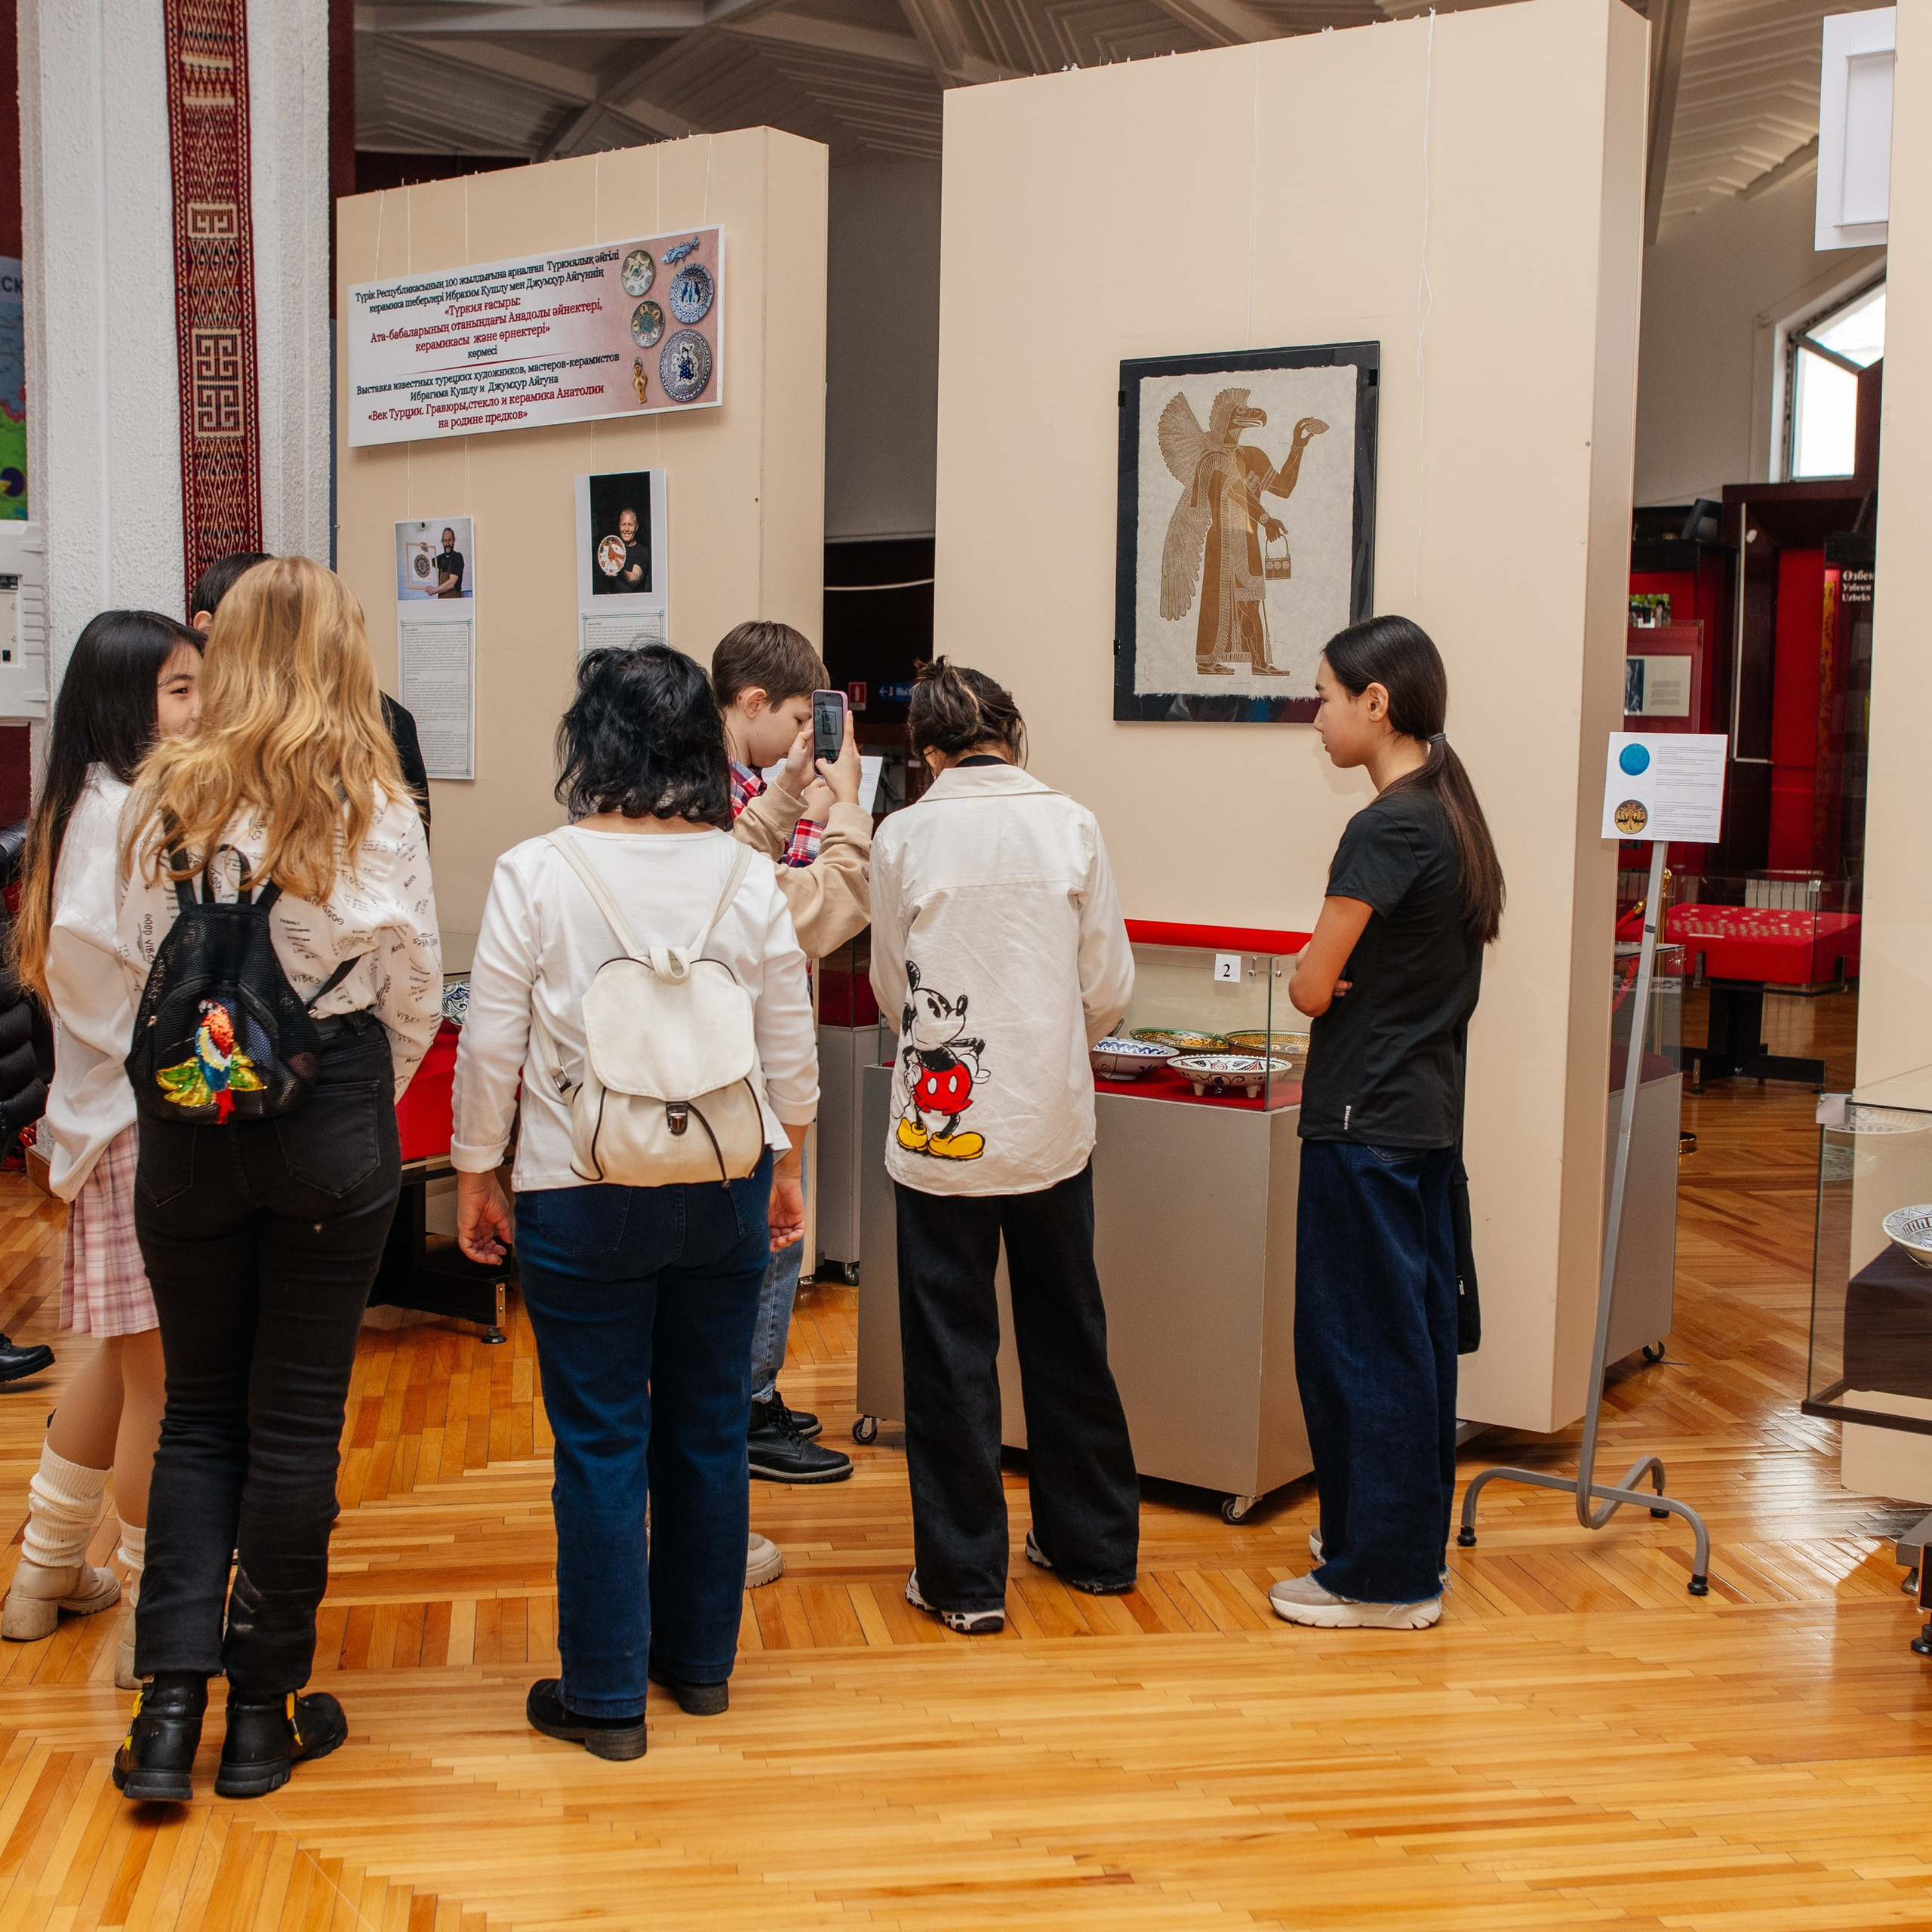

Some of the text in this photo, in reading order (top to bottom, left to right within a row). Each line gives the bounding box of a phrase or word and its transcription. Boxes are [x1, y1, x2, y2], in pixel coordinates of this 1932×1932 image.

[355, 249, 620, 303] Түрік Республикасының 100 жылдығына арналған Түркиялық әйгілі
[369, 303, 404, 314] керамика
[405, 292, 445, 307] шеберлері
[445, 290, 479, 303] Ибрахим
[509, 281, 525, 291] мен
[526, 275, 565, 291] Джумхур
[565, 267, 605, 282] Айгүннің
[371, 297, 603, 343] Ата-бабаларының отанындағы Анадолы әйнектері,
[445, 297, 521, 318] «Түркия ғасыры:
[415, 322, 551, 353] керамикасы және өрнектері»
[467, 345, 497, 360] көрмесі
[356, 353, 620, 395] Выставка известных турецких художников, мастеров-керамистов
[410, 390, 449, 402] Ибрагима
[488, 380, 527, 393] Джумхур
[528, 375, 558, 387] Айгуна
[368, 410, 388, 420] «Век
[389, 406, 424, 421] Турции.
[509, 391, 555, 406] керамика
[556, 384, 605, 398] Анатолии
[438, 410, 528, 429] на родине предков»
[143, 913, 154, 936] GOOD
[322, 904, 345, 925] GOOD
[291, 974, 321, 985] VIBES
[1223, 963, 1231, 978] 2
